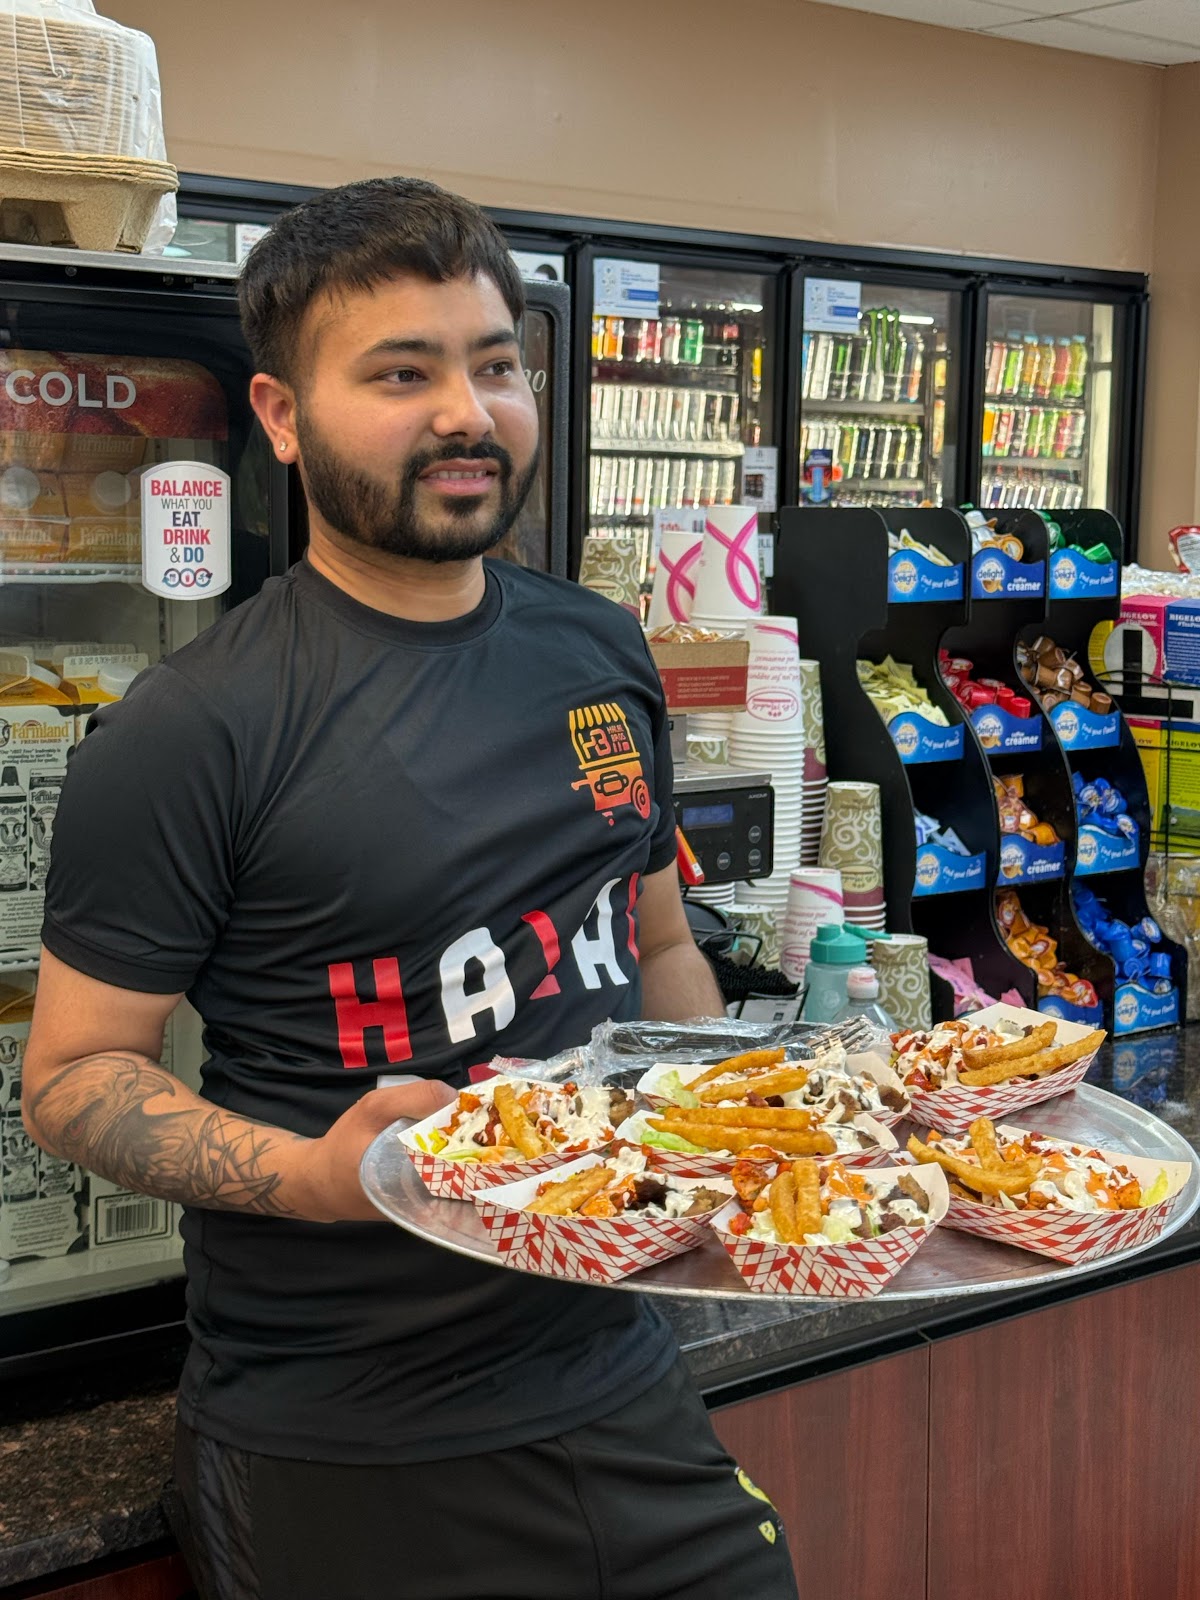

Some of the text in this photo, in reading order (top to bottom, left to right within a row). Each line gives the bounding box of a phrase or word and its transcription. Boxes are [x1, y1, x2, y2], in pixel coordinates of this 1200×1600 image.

[5, 369, 137, 409] COLD
[151, 480, 222, 497] BALANCE
[161, 498, 212, 510] WHAT YOU
[163, 529, 211, 545] DRINK
[169, 546, 204, 563] & DO
[977, 569, 1004, 581] delight
[1006, 581, 1041, 592] creamer
[1168, 613, 1200, 623] BIGELO
[12, 721, 70, 739] Farmland
[976, 725, 1002, 737] delight
[1004, 735, 1039, 747] creamer
[1026, 862, 1061, 876] creamer
